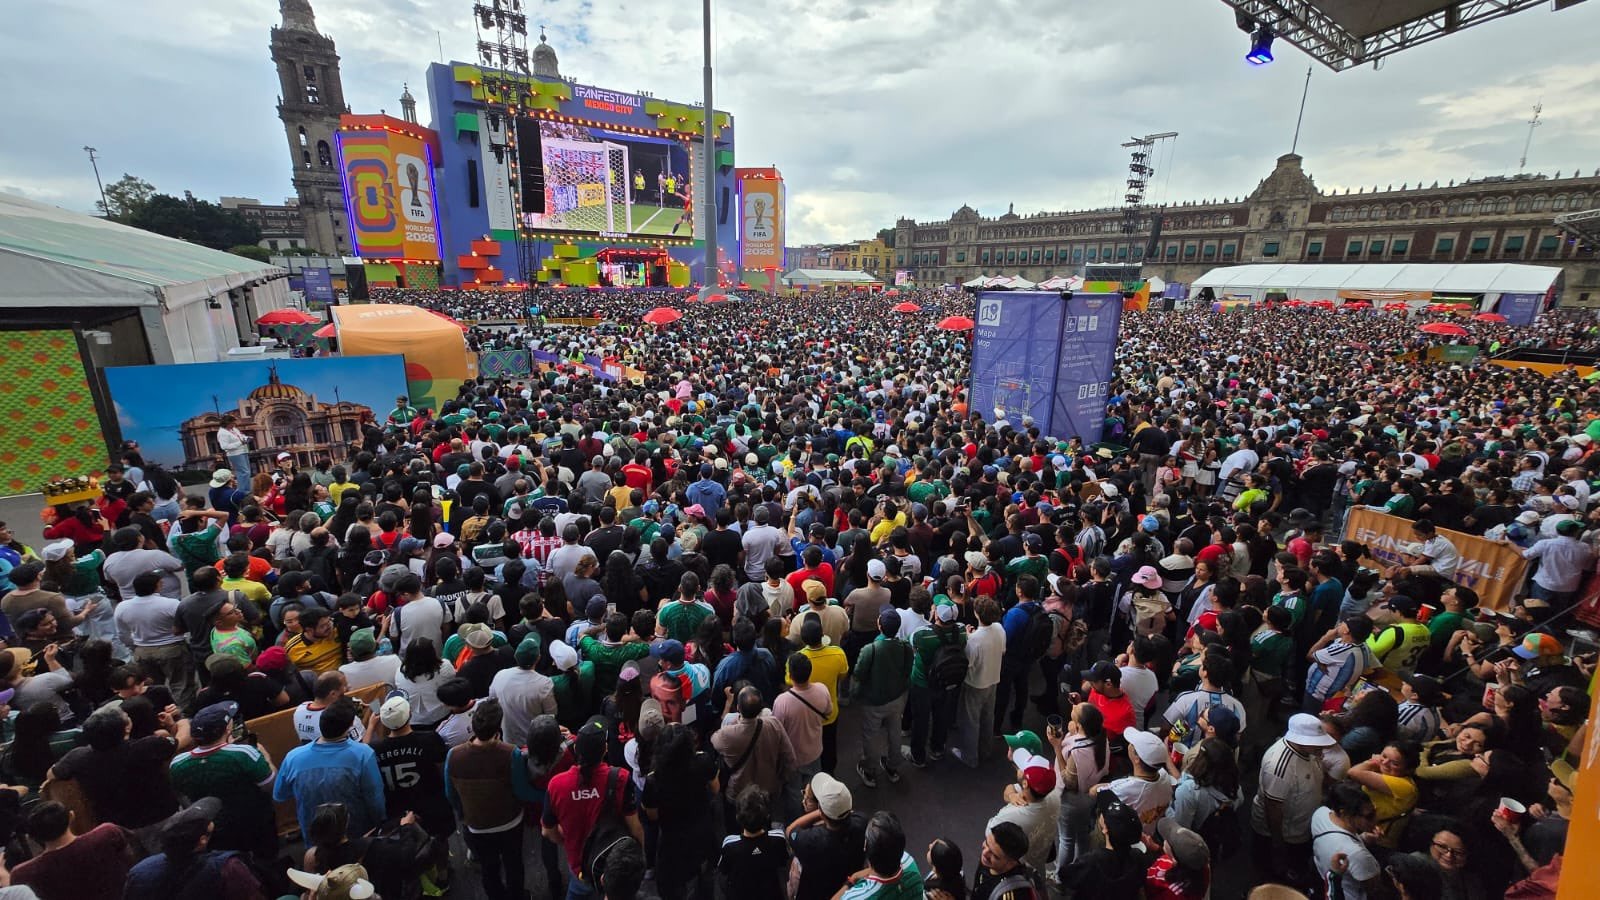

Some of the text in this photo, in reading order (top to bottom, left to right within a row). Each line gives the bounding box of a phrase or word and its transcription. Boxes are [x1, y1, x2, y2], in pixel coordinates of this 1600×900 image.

[584, 99, 633, 115] MEXICO CITY
[406, 232, 435, 243] 2026
[745, 241, 775, 249] WORLD CUP
[745, 248, 775, 256] 2026
[977, 328, 997, 339] Mapa
[977, 339, 991, 350] Map
[380, 761, 421, 791] 15
[571, 787, 600, 801] USA
